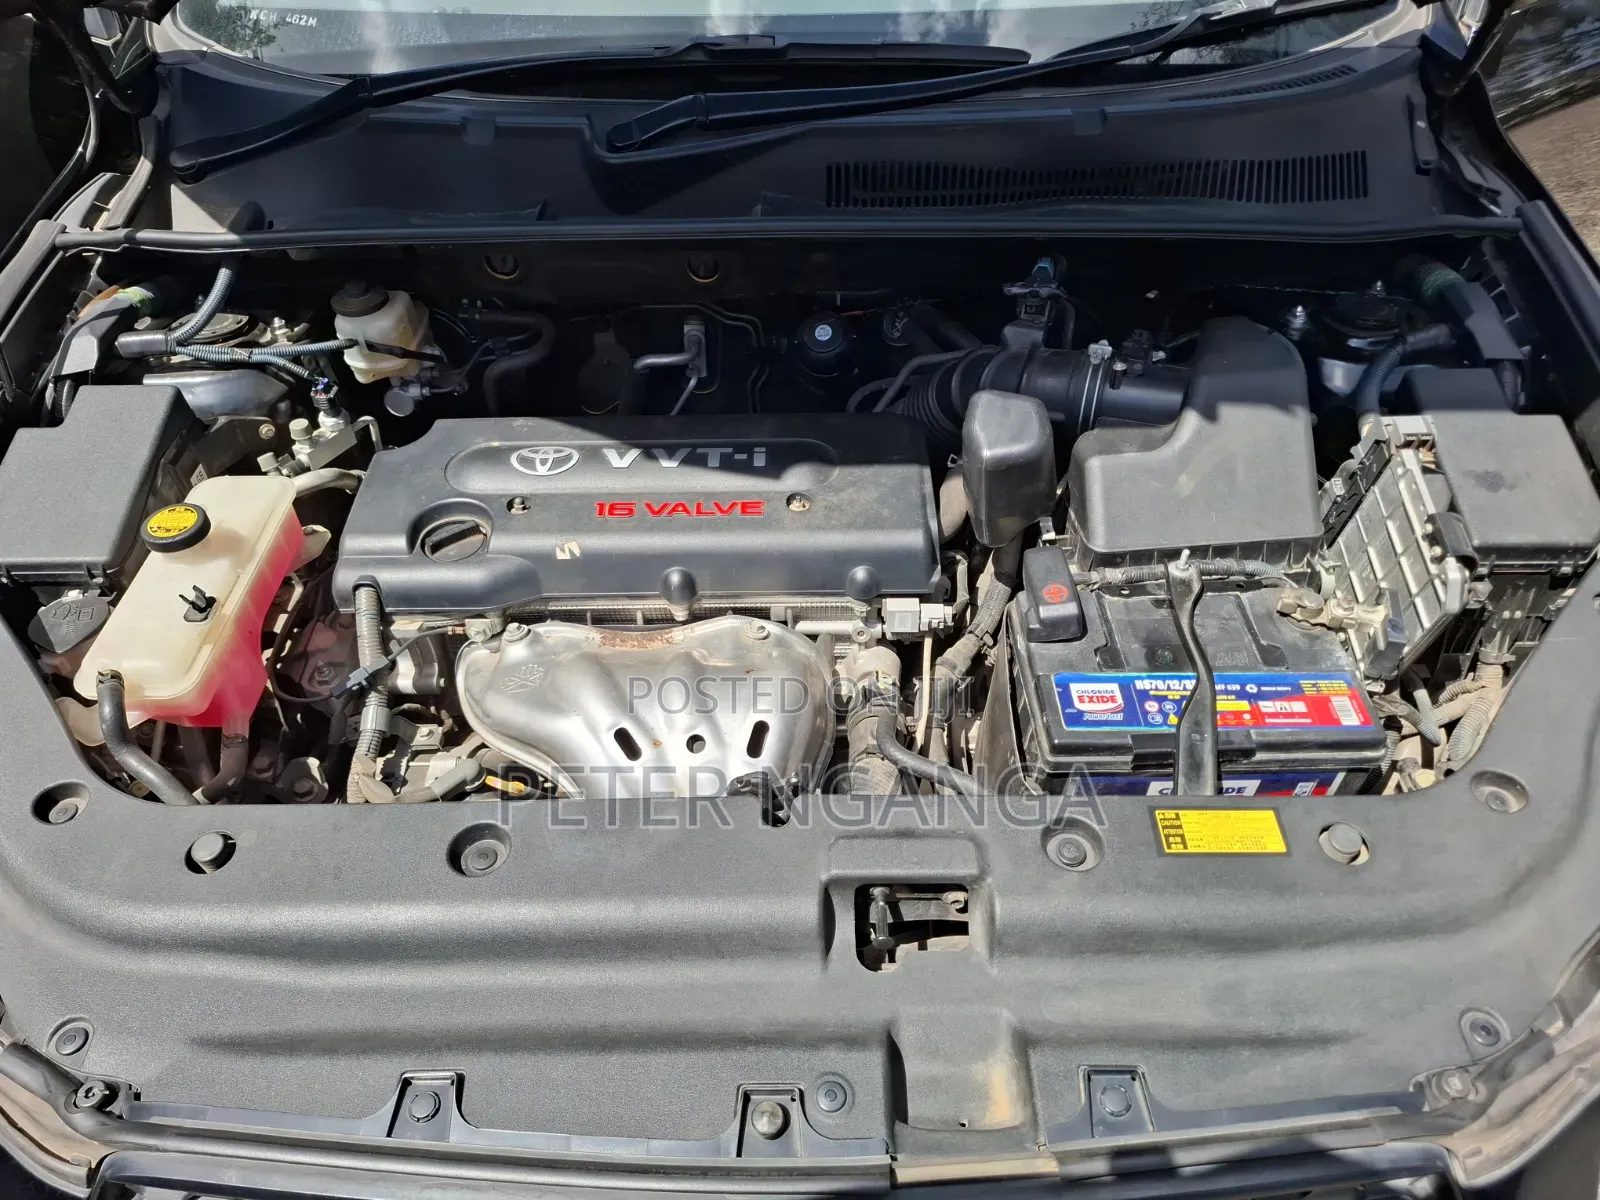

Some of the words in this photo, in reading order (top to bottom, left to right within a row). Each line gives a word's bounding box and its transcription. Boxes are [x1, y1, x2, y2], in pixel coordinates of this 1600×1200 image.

[249, 9, 278, 22] KCH
[285, 13, 318, 28] 462M
[602, 446, 767, 469] VVT-i
[594, 501, 637, 519] 16
[643, 500, 767, 519] VALVE
[1076, 695, 1118, 704] EXIDE
